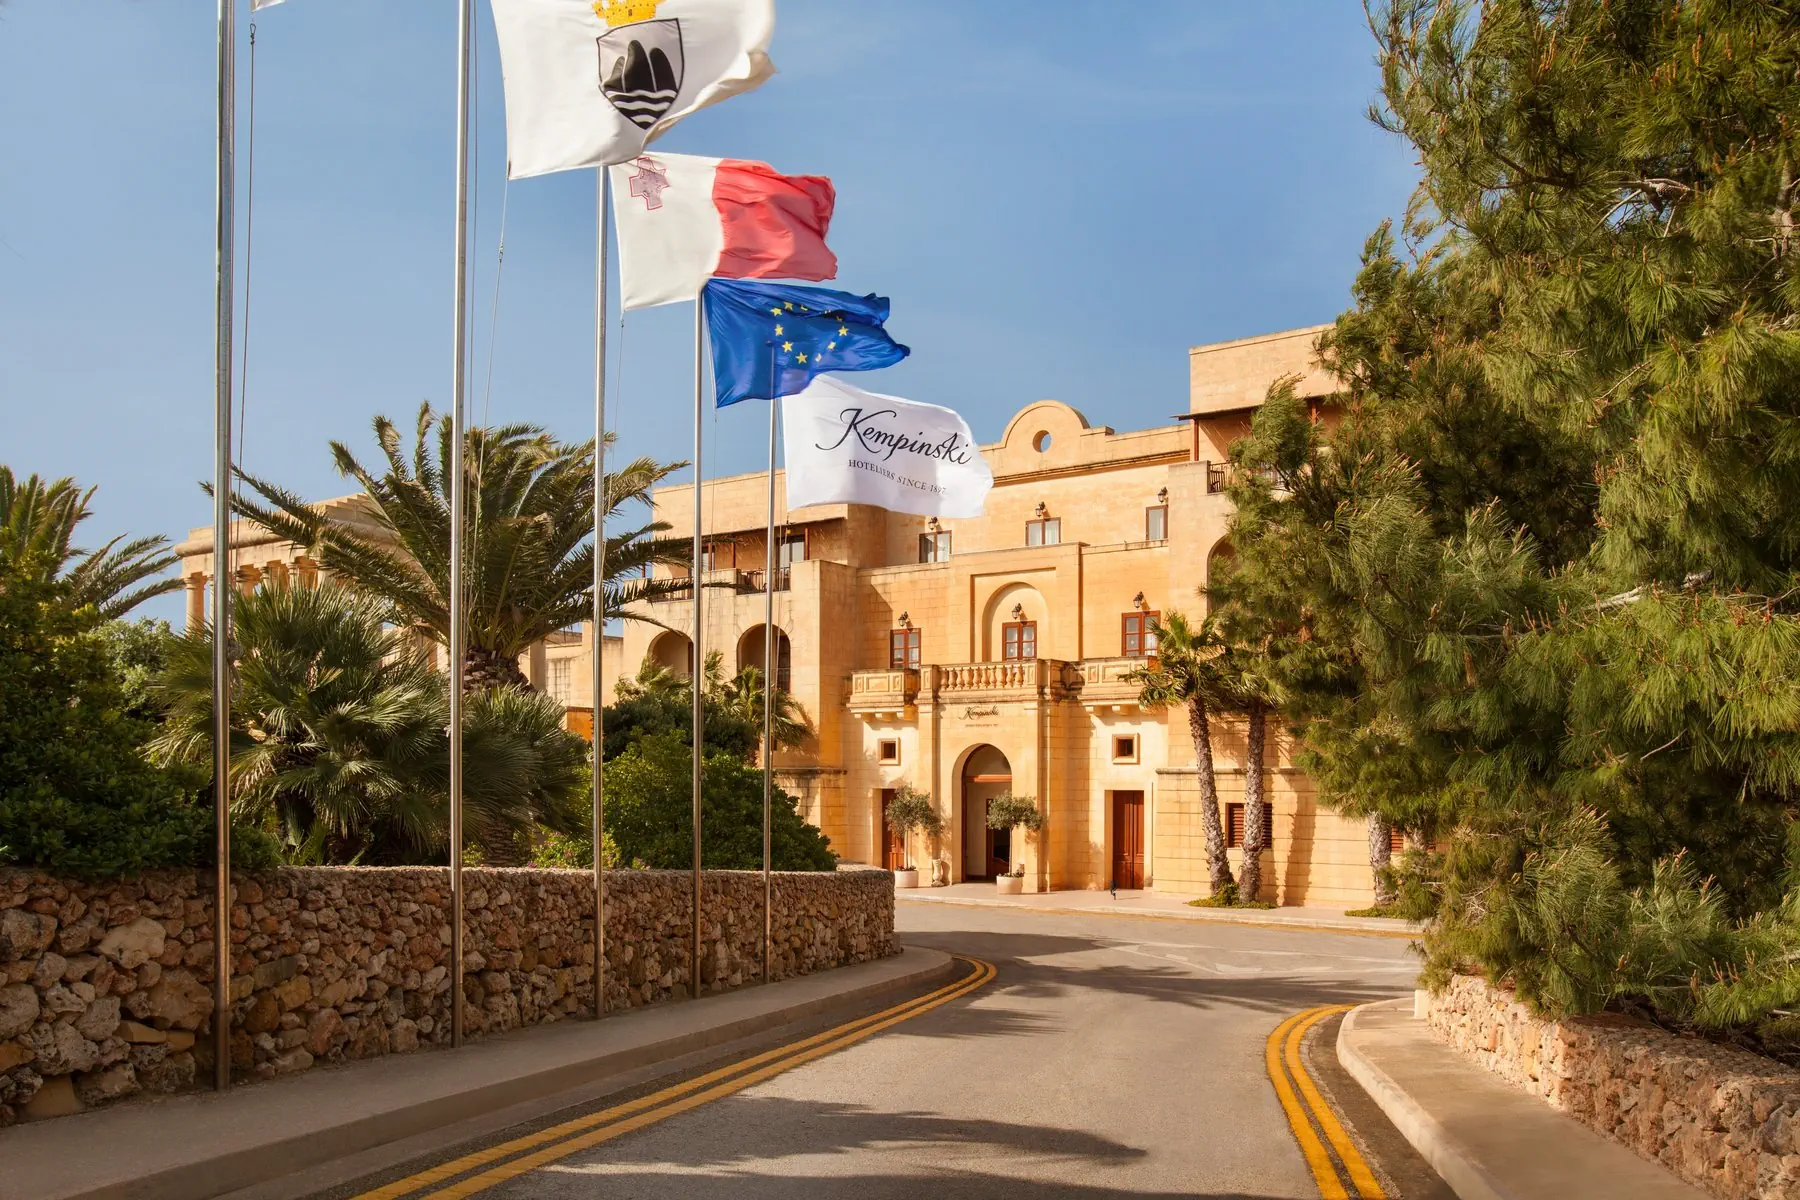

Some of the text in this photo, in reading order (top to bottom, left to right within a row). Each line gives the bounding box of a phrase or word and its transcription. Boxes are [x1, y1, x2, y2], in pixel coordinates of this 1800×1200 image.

[815, 408, 972, 465] Kempinski
[848, 459, 896, 481] HOTELIERS
[897, 476, 927, 491] SINCE
